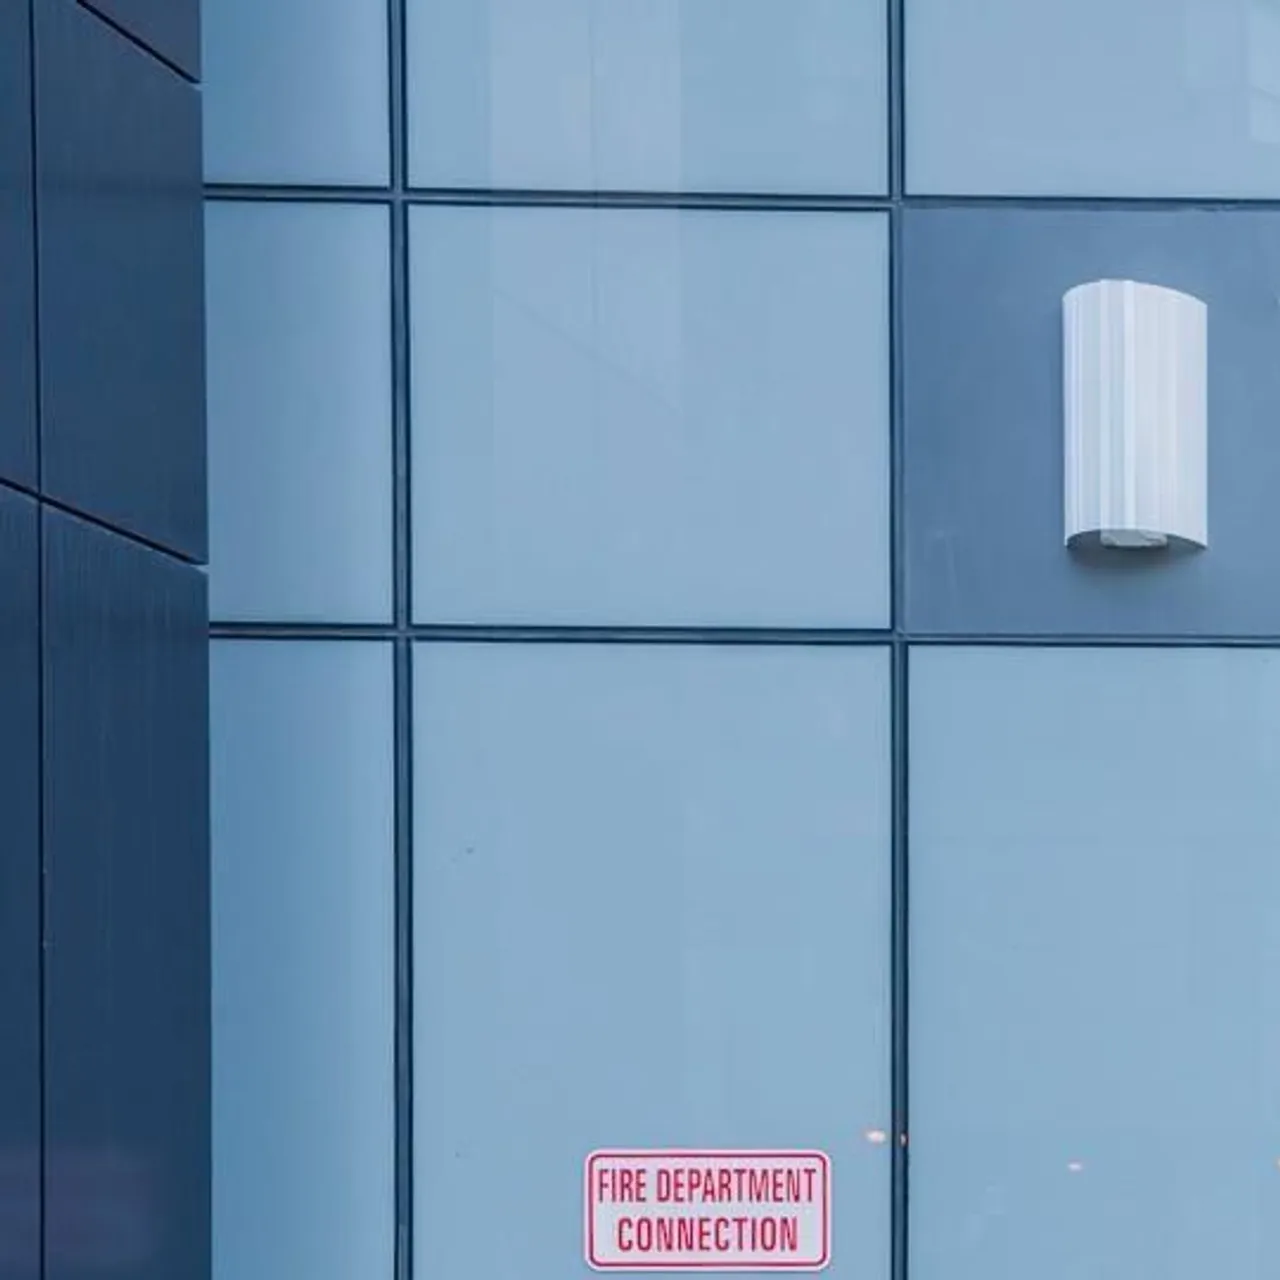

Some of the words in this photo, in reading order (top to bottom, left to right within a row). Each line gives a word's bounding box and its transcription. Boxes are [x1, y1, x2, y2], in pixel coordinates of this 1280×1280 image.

[598, 1167, 648, 1203] FIRE
[656, 1167, 817, 1204] DEPARTMENT
[617, 1216, 798, 1252] CONNECTION
